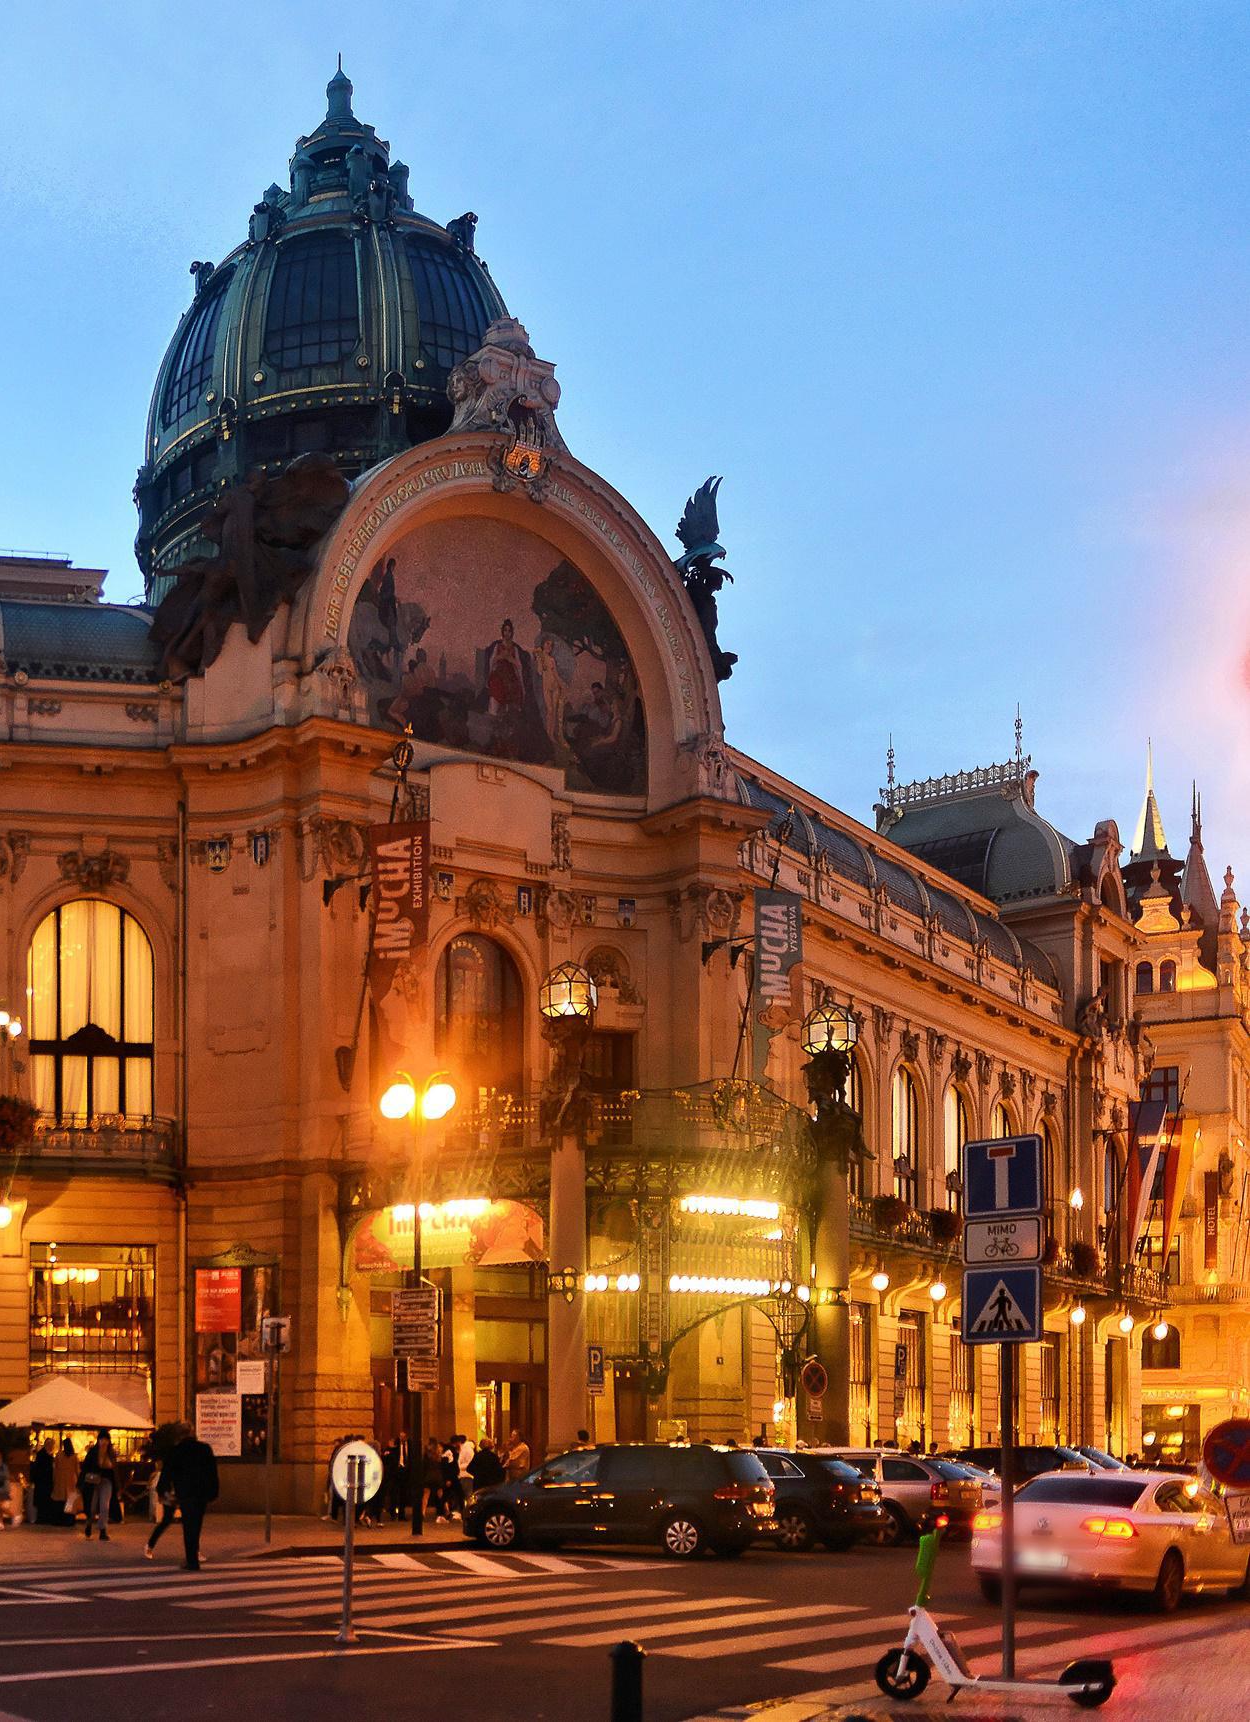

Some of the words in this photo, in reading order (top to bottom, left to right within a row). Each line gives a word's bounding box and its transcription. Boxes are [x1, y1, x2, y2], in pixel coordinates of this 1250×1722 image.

[412, 835, 423, 909] EXHIBITION
[987, 1224, 1017, 1235] MIMO
[1207, 1206, 1216, 1235] HOTEL
